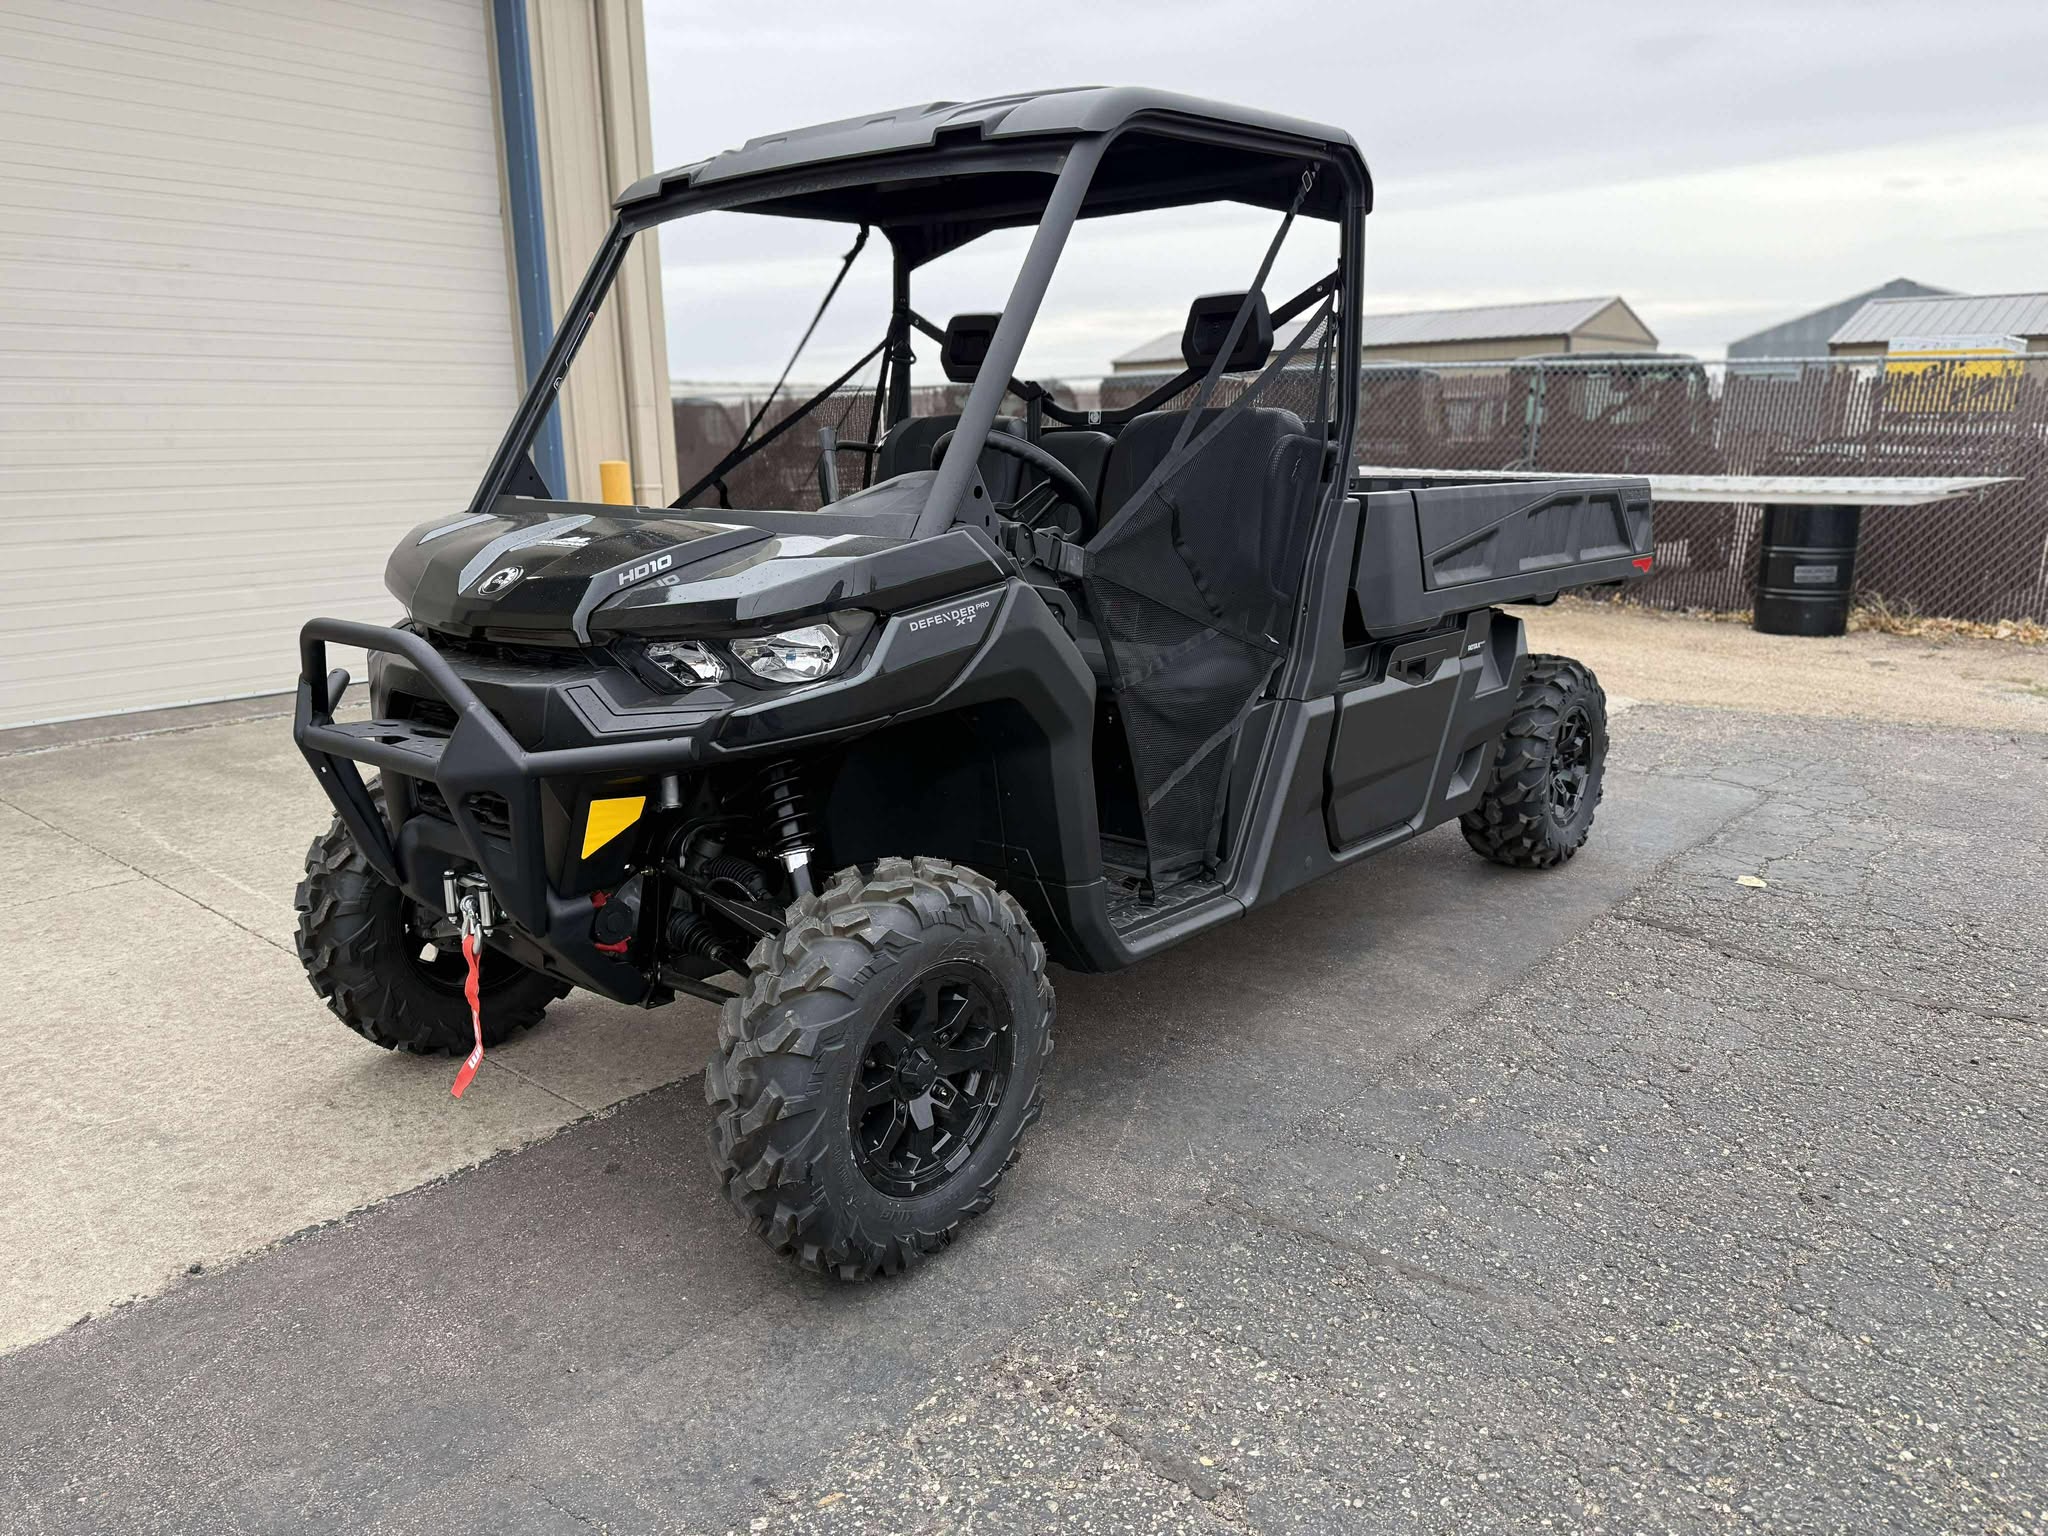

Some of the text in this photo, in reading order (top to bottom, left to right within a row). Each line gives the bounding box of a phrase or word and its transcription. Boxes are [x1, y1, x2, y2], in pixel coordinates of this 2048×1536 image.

[618, 554, 672, 586] HD10
[909, 601, 990, 632] DEFENDER PRO
[955, 614, 977, 627] XT
